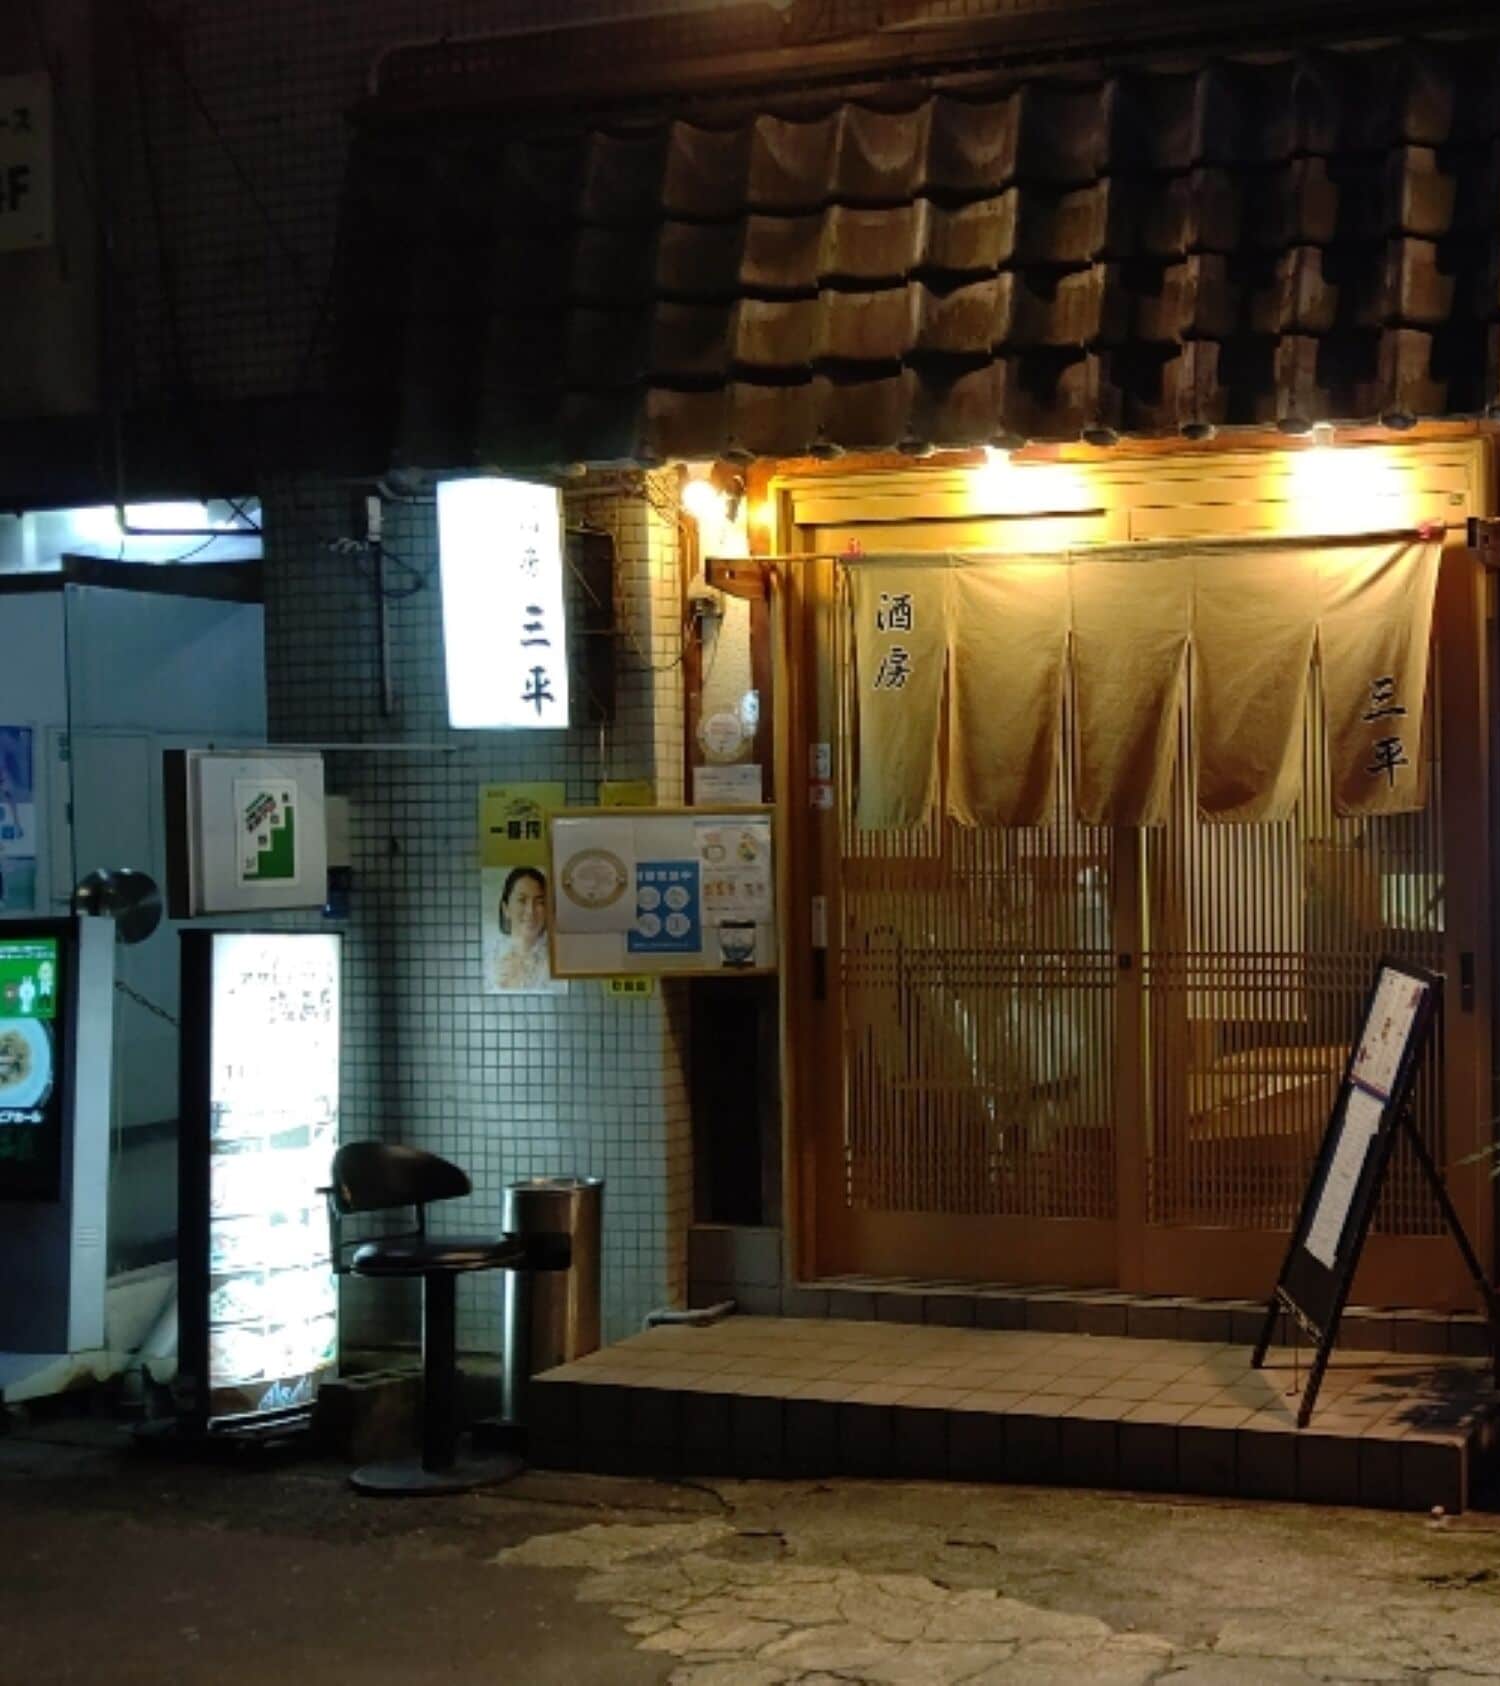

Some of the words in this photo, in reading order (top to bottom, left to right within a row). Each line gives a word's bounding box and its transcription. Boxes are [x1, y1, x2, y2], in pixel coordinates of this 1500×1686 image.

[0, 165, 30, 211] F
[875, 593, 912, 688] 酒房
[1362, 677, 1408, 787] 三平
